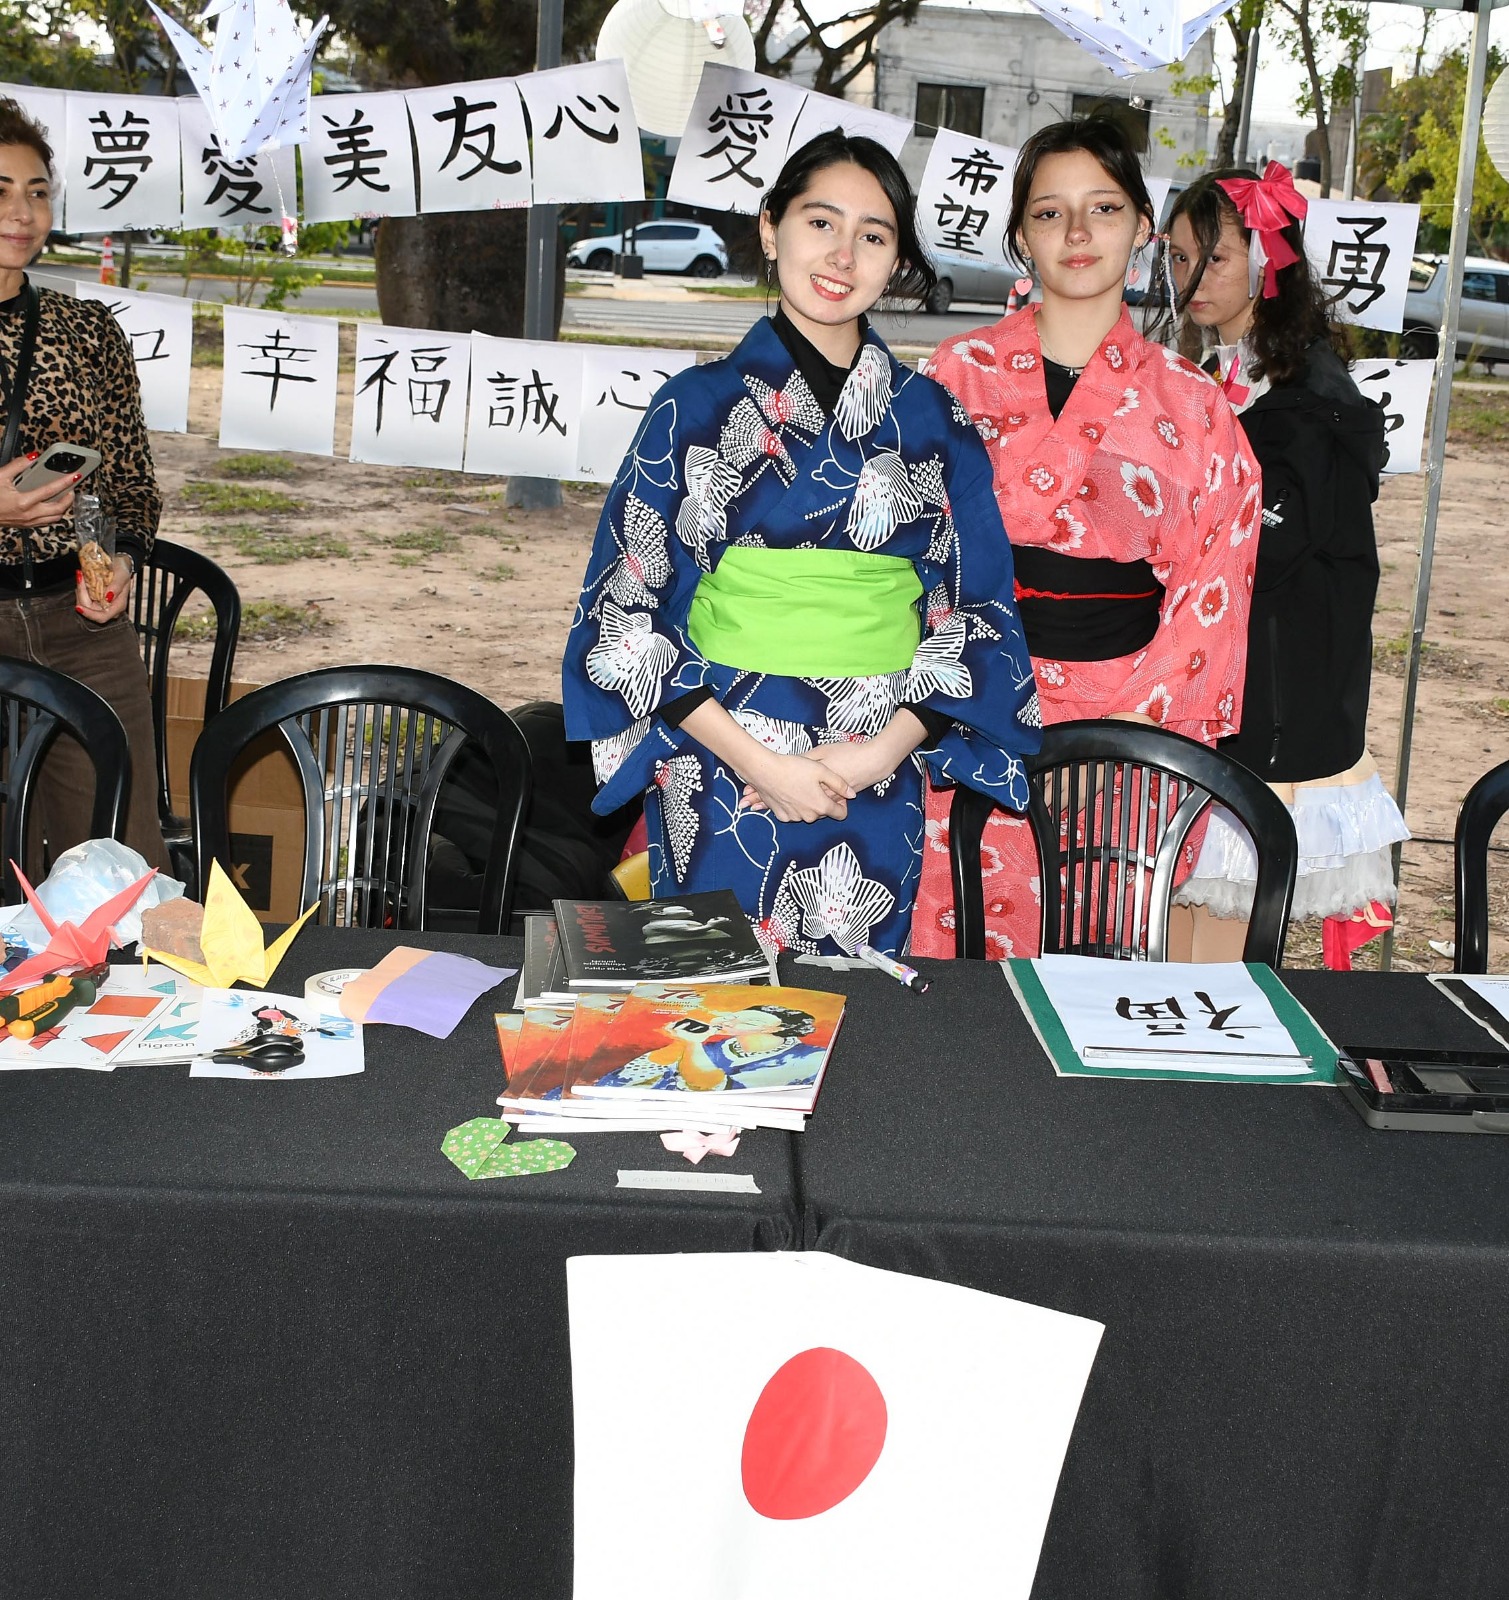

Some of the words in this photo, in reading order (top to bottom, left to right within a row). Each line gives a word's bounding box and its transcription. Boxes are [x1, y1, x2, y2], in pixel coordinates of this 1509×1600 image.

[83, 111, 153, 210] 夢
[323, 109, 391, 193] 美
[433, 96, 522, 182] 友
[543, 95, 620, 144] 心
[698, 88, 774, 188] 愛
[933, 148, 1005, 256] 希望
[1321, 216, 1390, 314] 勇
[238, 329, 317, 411] 幸
[356, 338, 452, 435] 福
[488, 370, 568, 437] 誠
[138, 1042, 195, 1050] Pigeon
